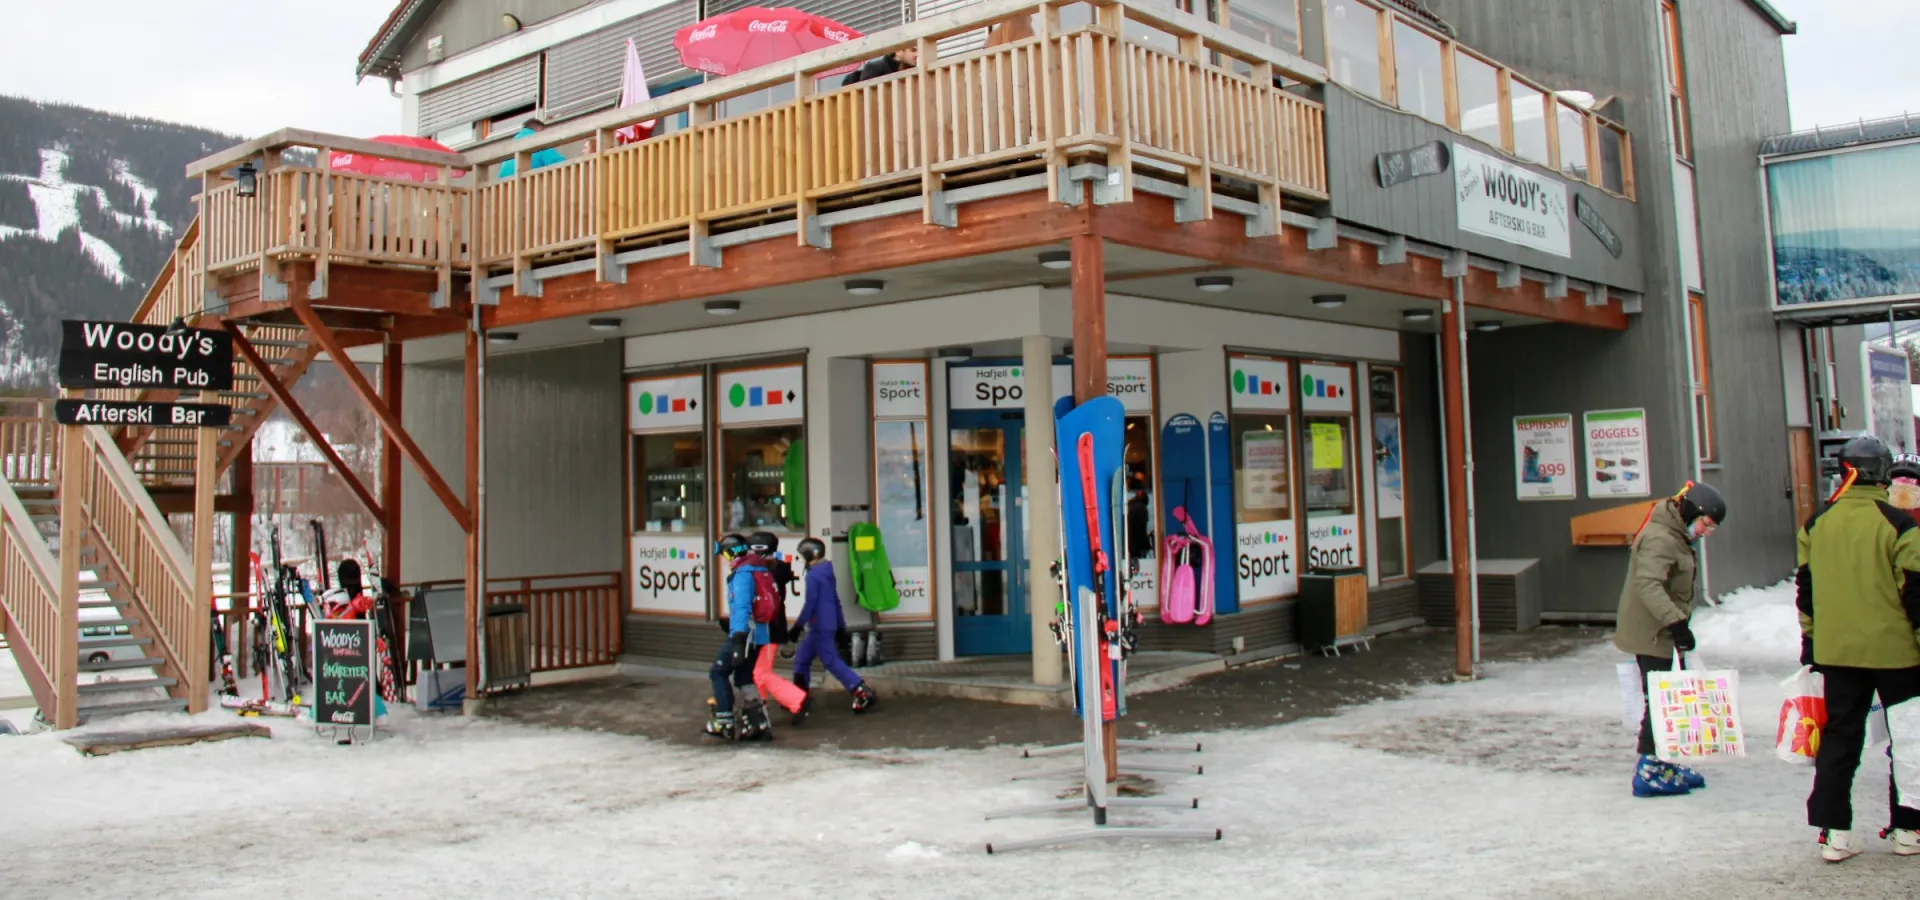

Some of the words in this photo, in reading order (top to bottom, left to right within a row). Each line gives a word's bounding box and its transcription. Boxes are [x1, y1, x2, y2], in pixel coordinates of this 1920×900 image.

[1489, 210, 1526, 233] AFTERSKI
[1532, 222, 1546, 238] BAR
[83, 322, 213, 359] Woody's
[94, 363, 163, 386] English
[174, 367, 209, 386] Pub
[976, 369, 1008, 379] Hafjell
[880, 388, 920, 401] Sport
[975, 382, 1023, 406] Spo
[1107, 382, 1146, 396] Sport
[76, 404, 152, 423] Afterski
[172, 407, 205, 424] Bar
[1592, 427, 1639, 439] GOGGELS
[1239, 533, 1263, 546] Hafjell
[640, 547, 667, 560] Hafjell
[1309, 544, 1353, 568] Sport
[1239, 550, 1289, 587] Sport
[639, 565, 701, 598] Sport
[1133, 578, 1153, 589] ort
[325, 690, 347, 706] BAR
